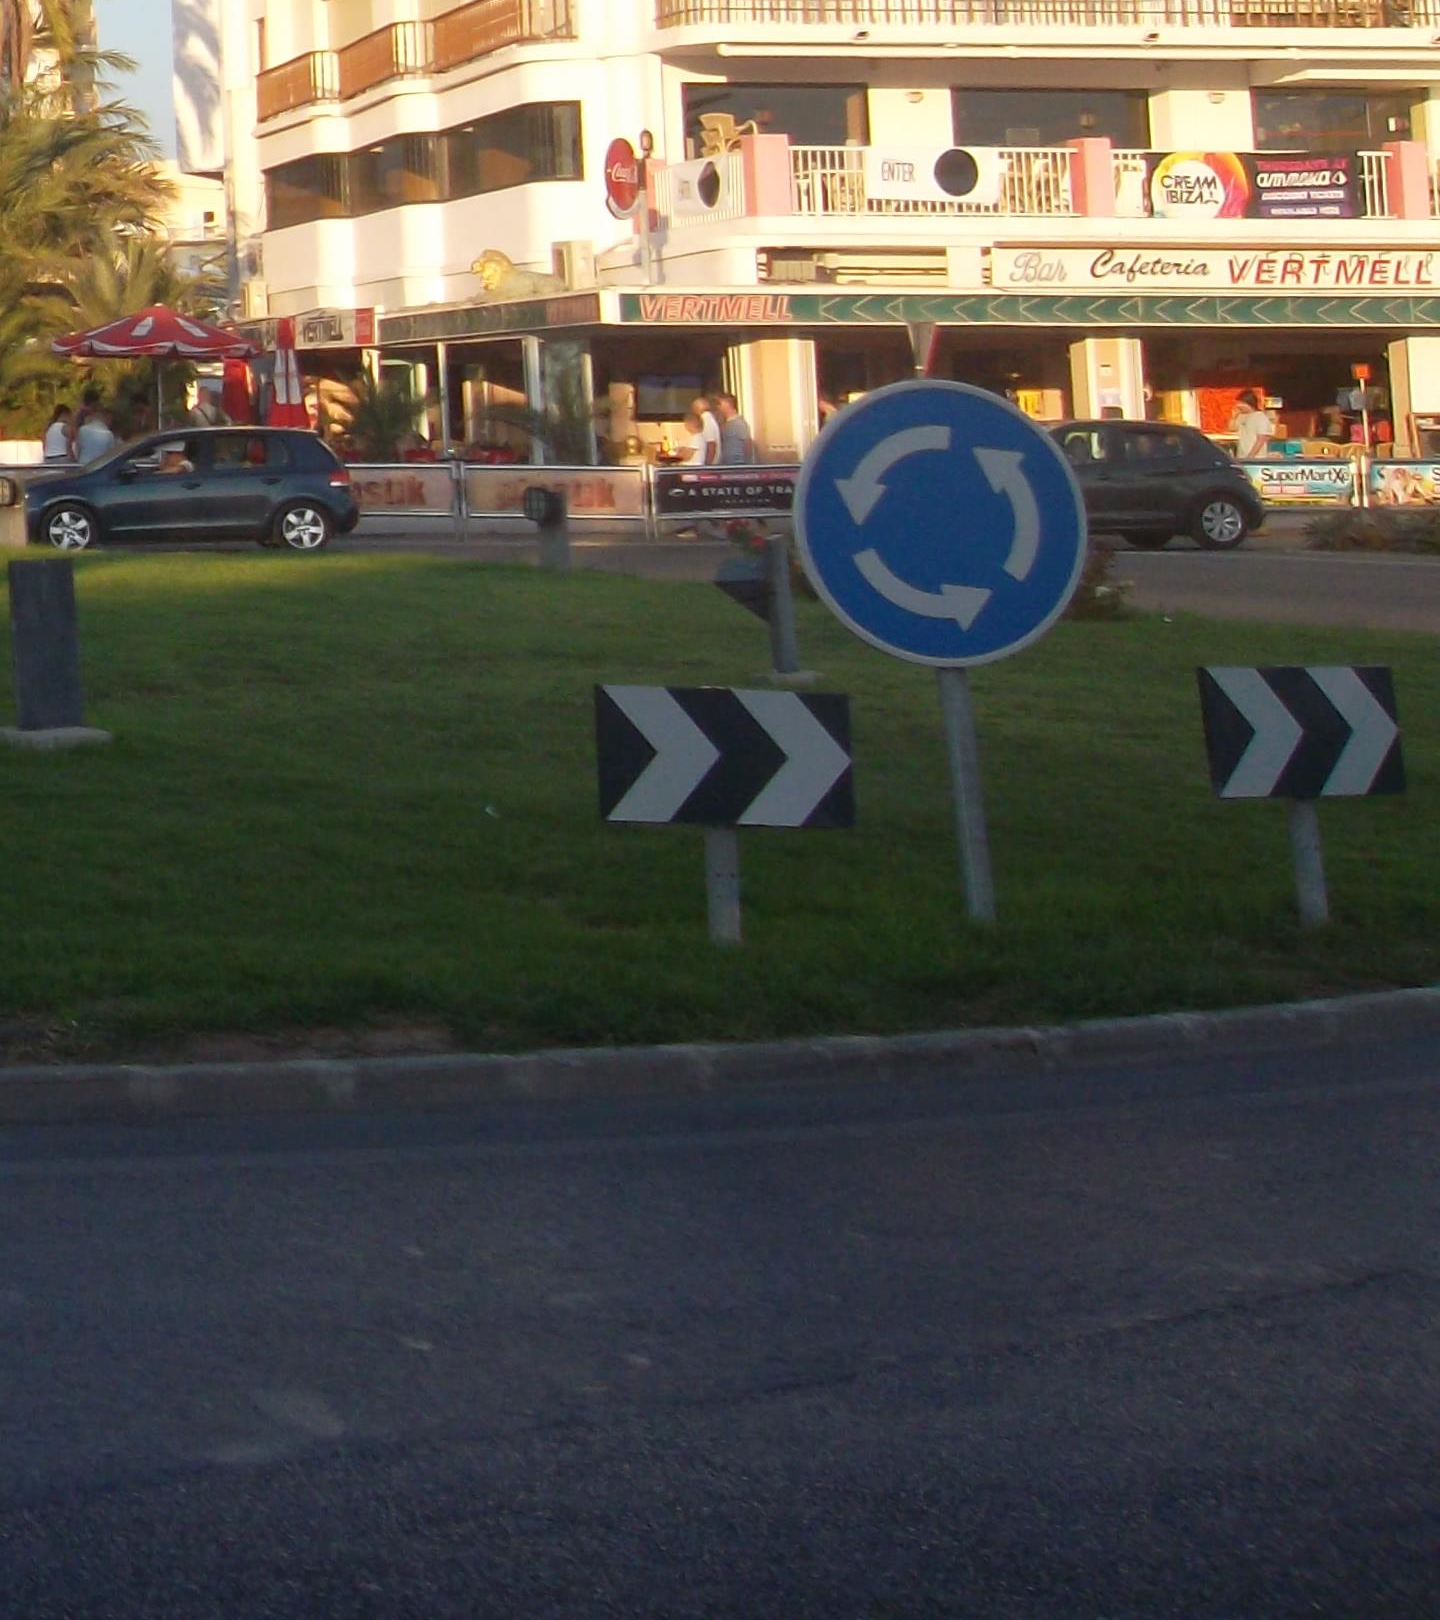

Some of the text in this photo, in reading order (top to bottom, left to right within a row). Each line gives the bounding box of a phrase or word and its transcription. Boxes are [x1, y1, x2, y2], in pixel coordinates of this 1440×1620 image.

[881, 161, 915, 182] ENTER
[1161, 175, 1217, 190] CREAM
[1166, 190, 1204, 204] IBIZA
[1009, 249, 1435, 284] Bar Cafeteria VERTMELL
[639, 295, 793, 321] VERTMELL
[701, 485, 740, 497] STATE
[767, 484, 793, 495] TRA
